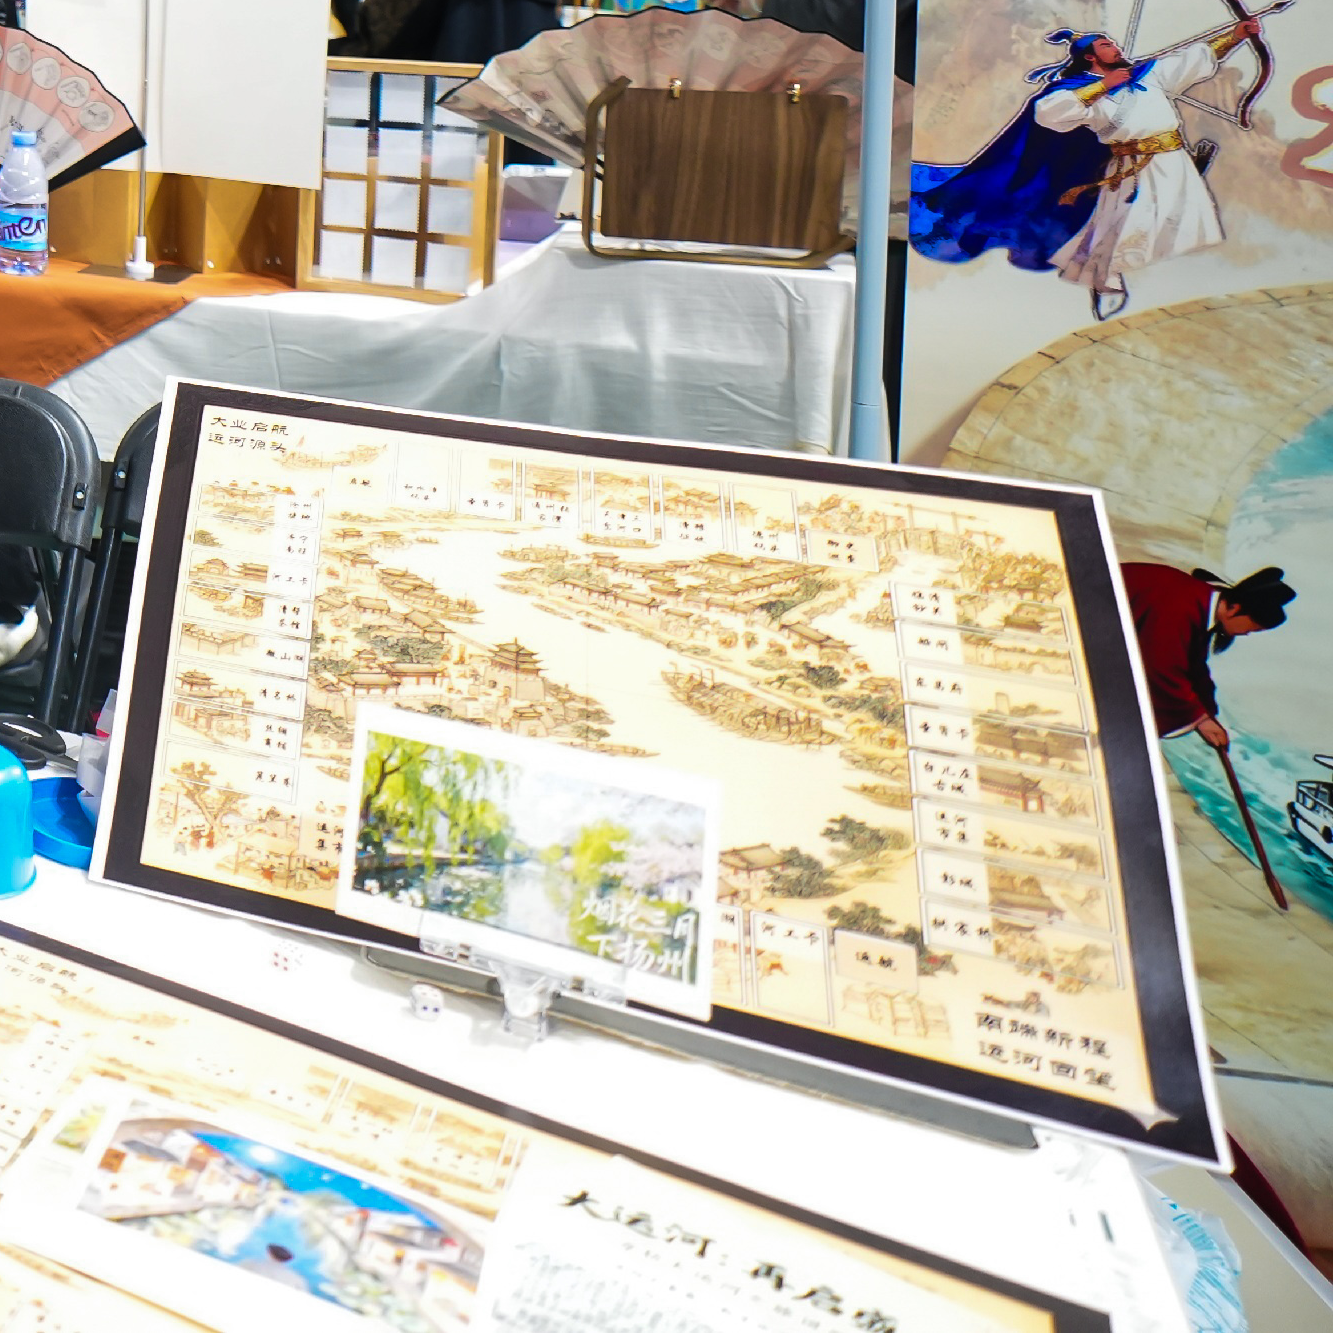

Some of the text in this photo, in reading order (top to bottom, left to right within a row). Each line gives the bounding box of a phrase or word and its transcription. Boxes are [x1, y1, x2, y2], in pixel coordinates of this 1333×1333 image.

[208, 433, 286, 454] 运河源头
[210, 416, 289, 436] 大业启航
[581, 890, 699, 944] 烟花三月
[587, 934, 695, 984] 下扬州
